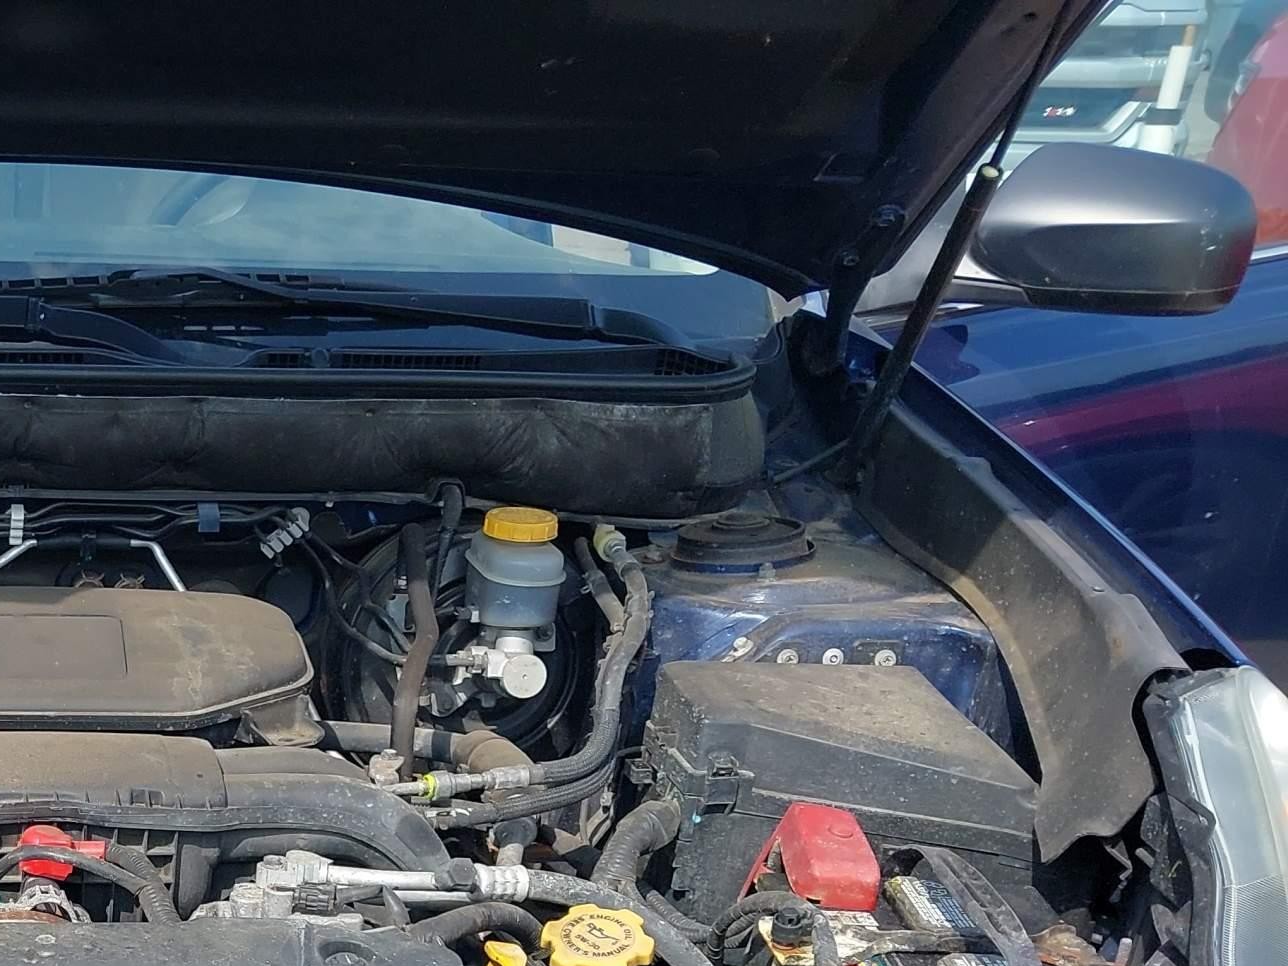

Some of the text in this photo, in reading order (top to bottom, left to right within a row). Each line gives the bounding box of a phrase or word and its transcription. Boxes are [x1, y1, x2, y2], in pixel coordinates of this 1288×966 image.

[567, 916, 585, 928] SEE
[592, 943, 631, 957] MANUAL
[589, 914, 633, 940] ENGINE OIL
